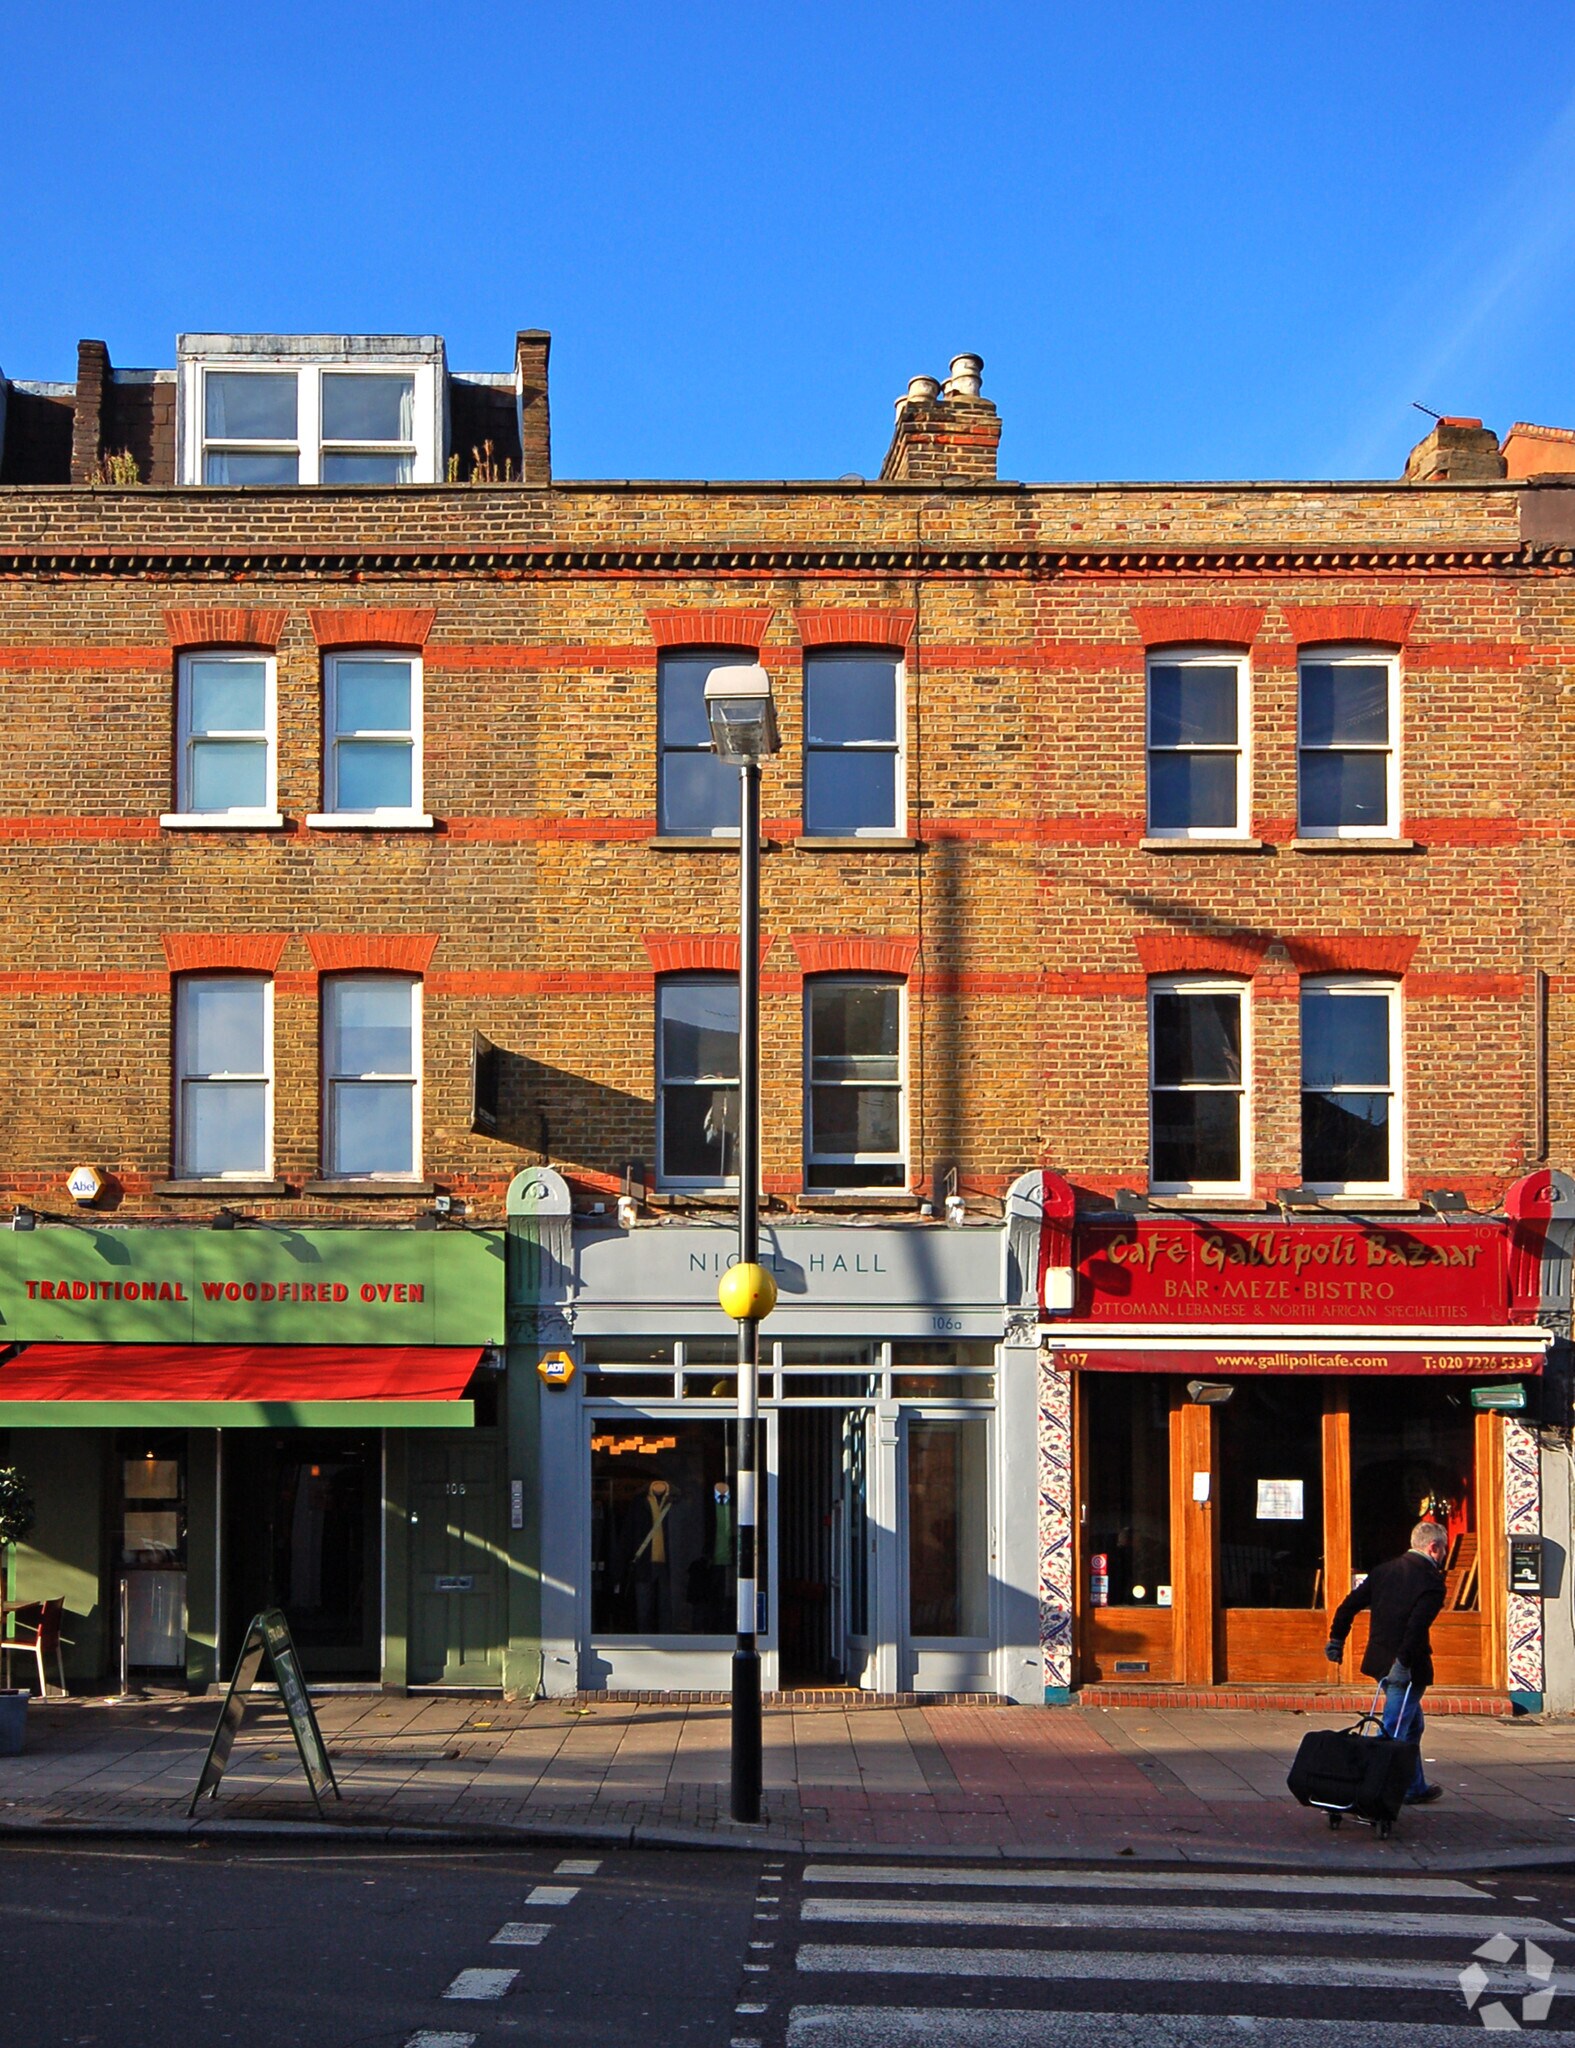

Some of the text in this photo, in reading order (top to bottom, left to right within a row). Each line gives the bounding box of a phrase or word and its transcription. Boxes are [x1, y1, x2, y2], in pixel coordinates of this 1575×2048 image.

[72, 1181, 95, 1191] Abel
[1475, 1227, 1500, 1239] 107
[1108, 1232, 1483, 1275] Café Gallipoli Bazaar
[809, 1253, 887, 1273] HALL
[25, 1280, 425, 1303] TRADITIONAL WOODFIRED OVEN
[1164, 1280, 1394, 1300] BAR MEZE BISTRO
[1177, 1303, 1246, 1317] LEBANESE
[1252, 1304, 1264, 1317] &
[1269, 1304, 1316, 1318] NORTH
[1322, 1304, 1377, 1318] AFRICAN
[1384, 1305, 1468, 1319] SPECIALITIES
[931, 1316, 963, 1331] 106a
[547, 1362, 564, 1372] ADT
[1062, 1353, 1089, 1367] 107
[1215, 1353, 1389, 1369] www.gallipolicafe.com
[1439, 1356, 1463, 1370] 020
[1466, 1356, 1498, 1370] 7226
[1500, 1356, 1533, 1370] 5333
